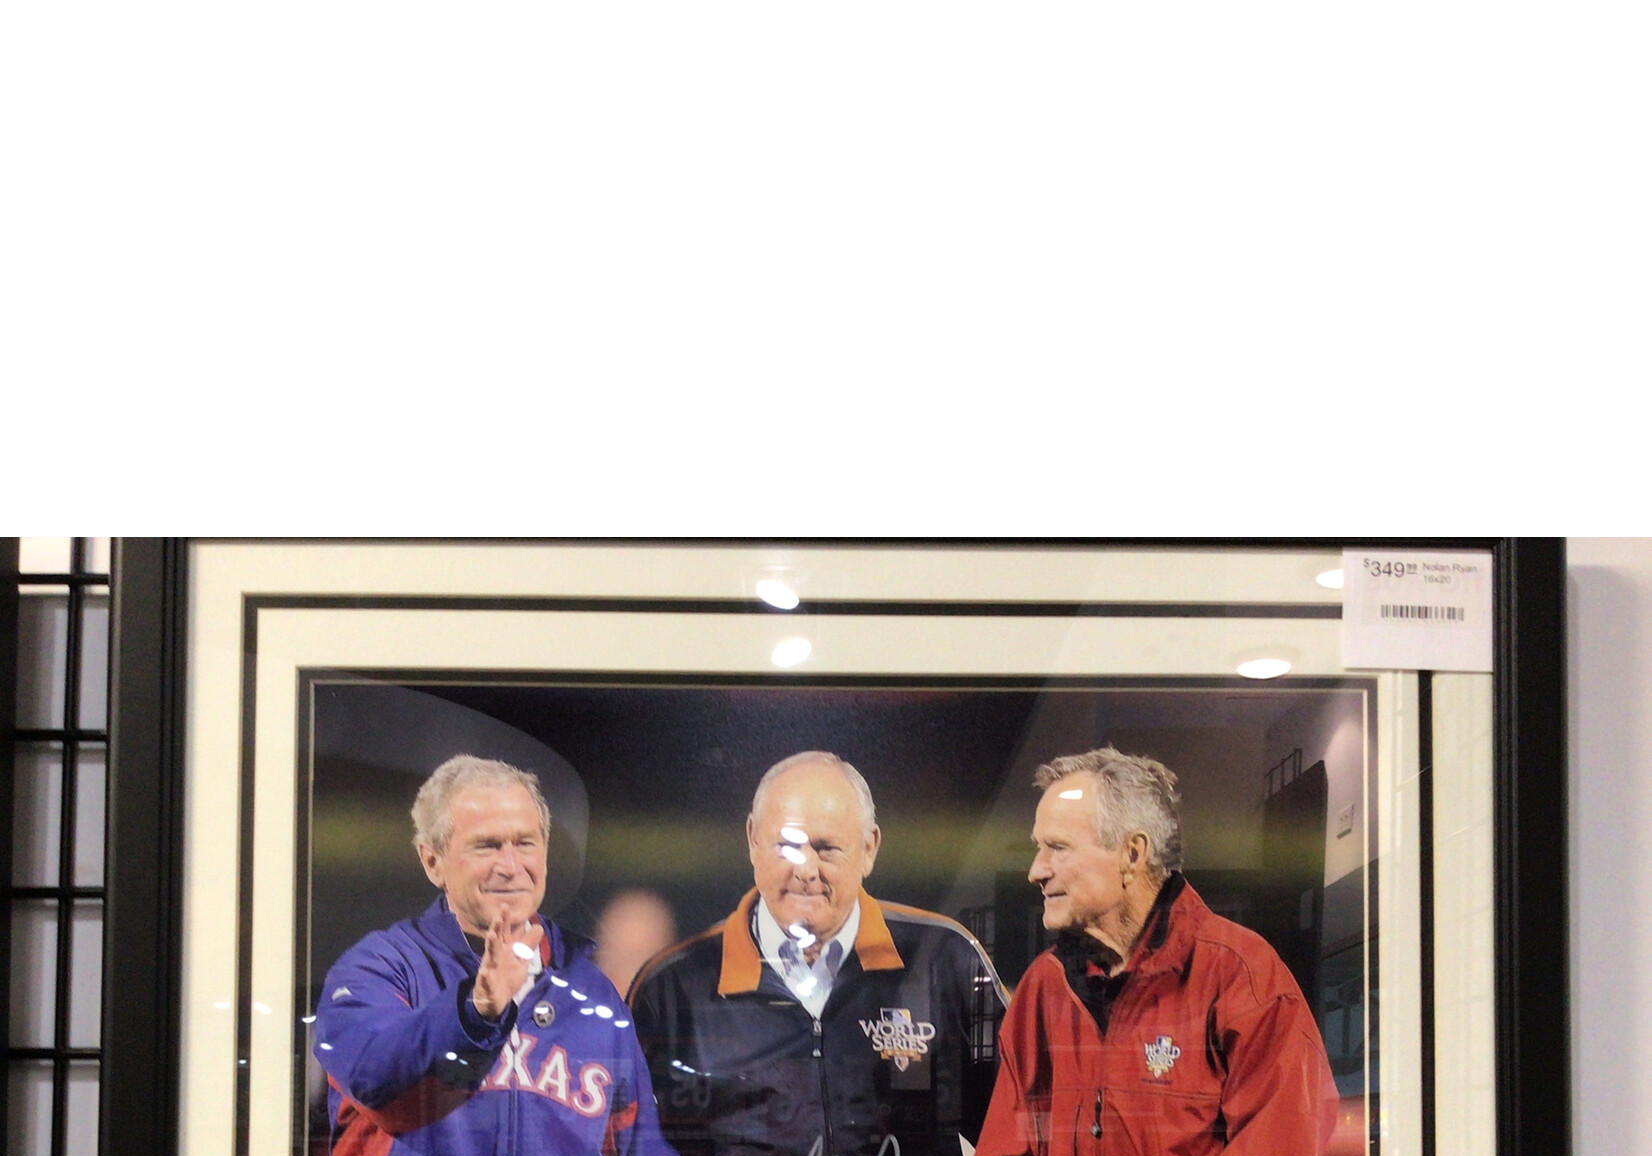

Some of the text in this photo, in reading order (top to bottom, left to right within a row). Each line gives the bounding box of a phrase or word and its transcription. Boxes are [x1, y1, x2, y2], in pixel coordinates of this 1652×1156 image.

[1422, 563, 1451, 573] Nolan
[1452, 564, 1478, 575] Ryan
[858, 1018, 937, 1041] WORLD
[871, 1034, 929, 1054] SERIES
